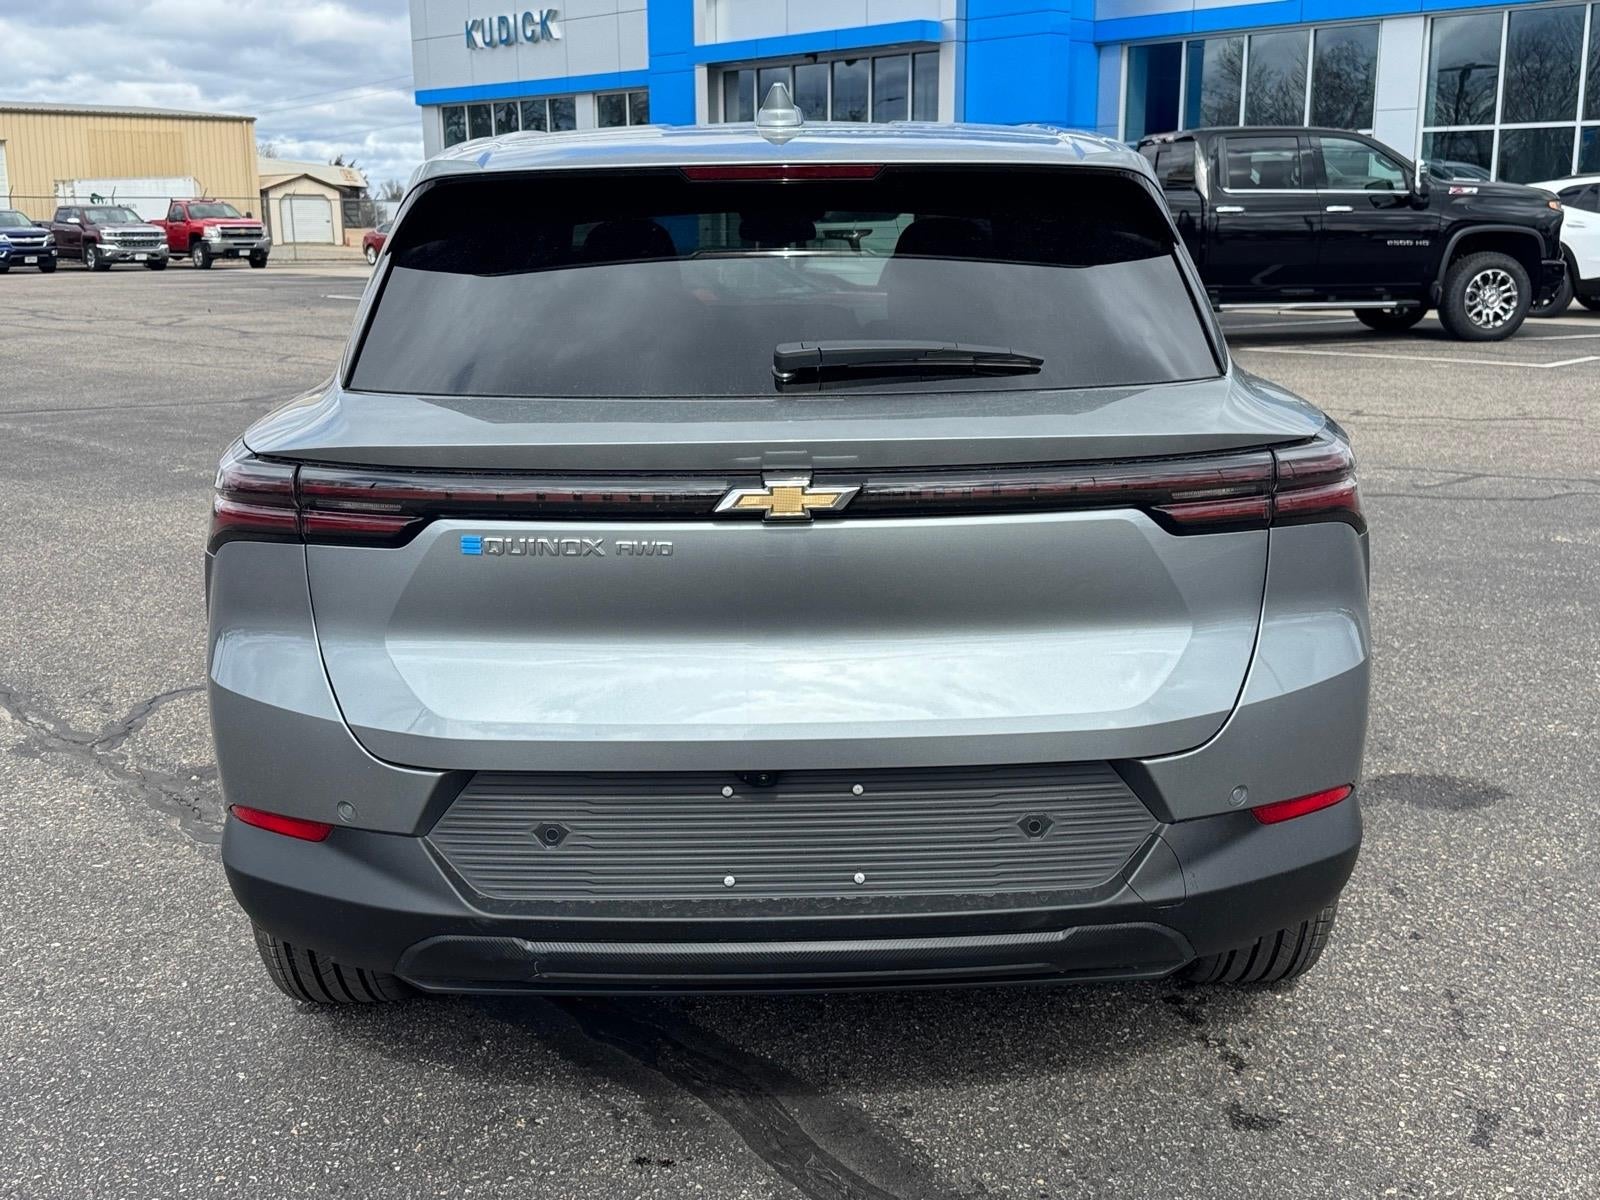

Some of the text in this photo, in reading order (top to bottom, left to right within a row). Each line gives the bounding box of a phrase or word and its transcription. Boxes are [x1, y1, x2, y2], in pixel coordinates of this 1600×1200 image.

[465, 9, 561, 50] KUDICK
[461, 536, 673, 556] EQUINOX AWD
